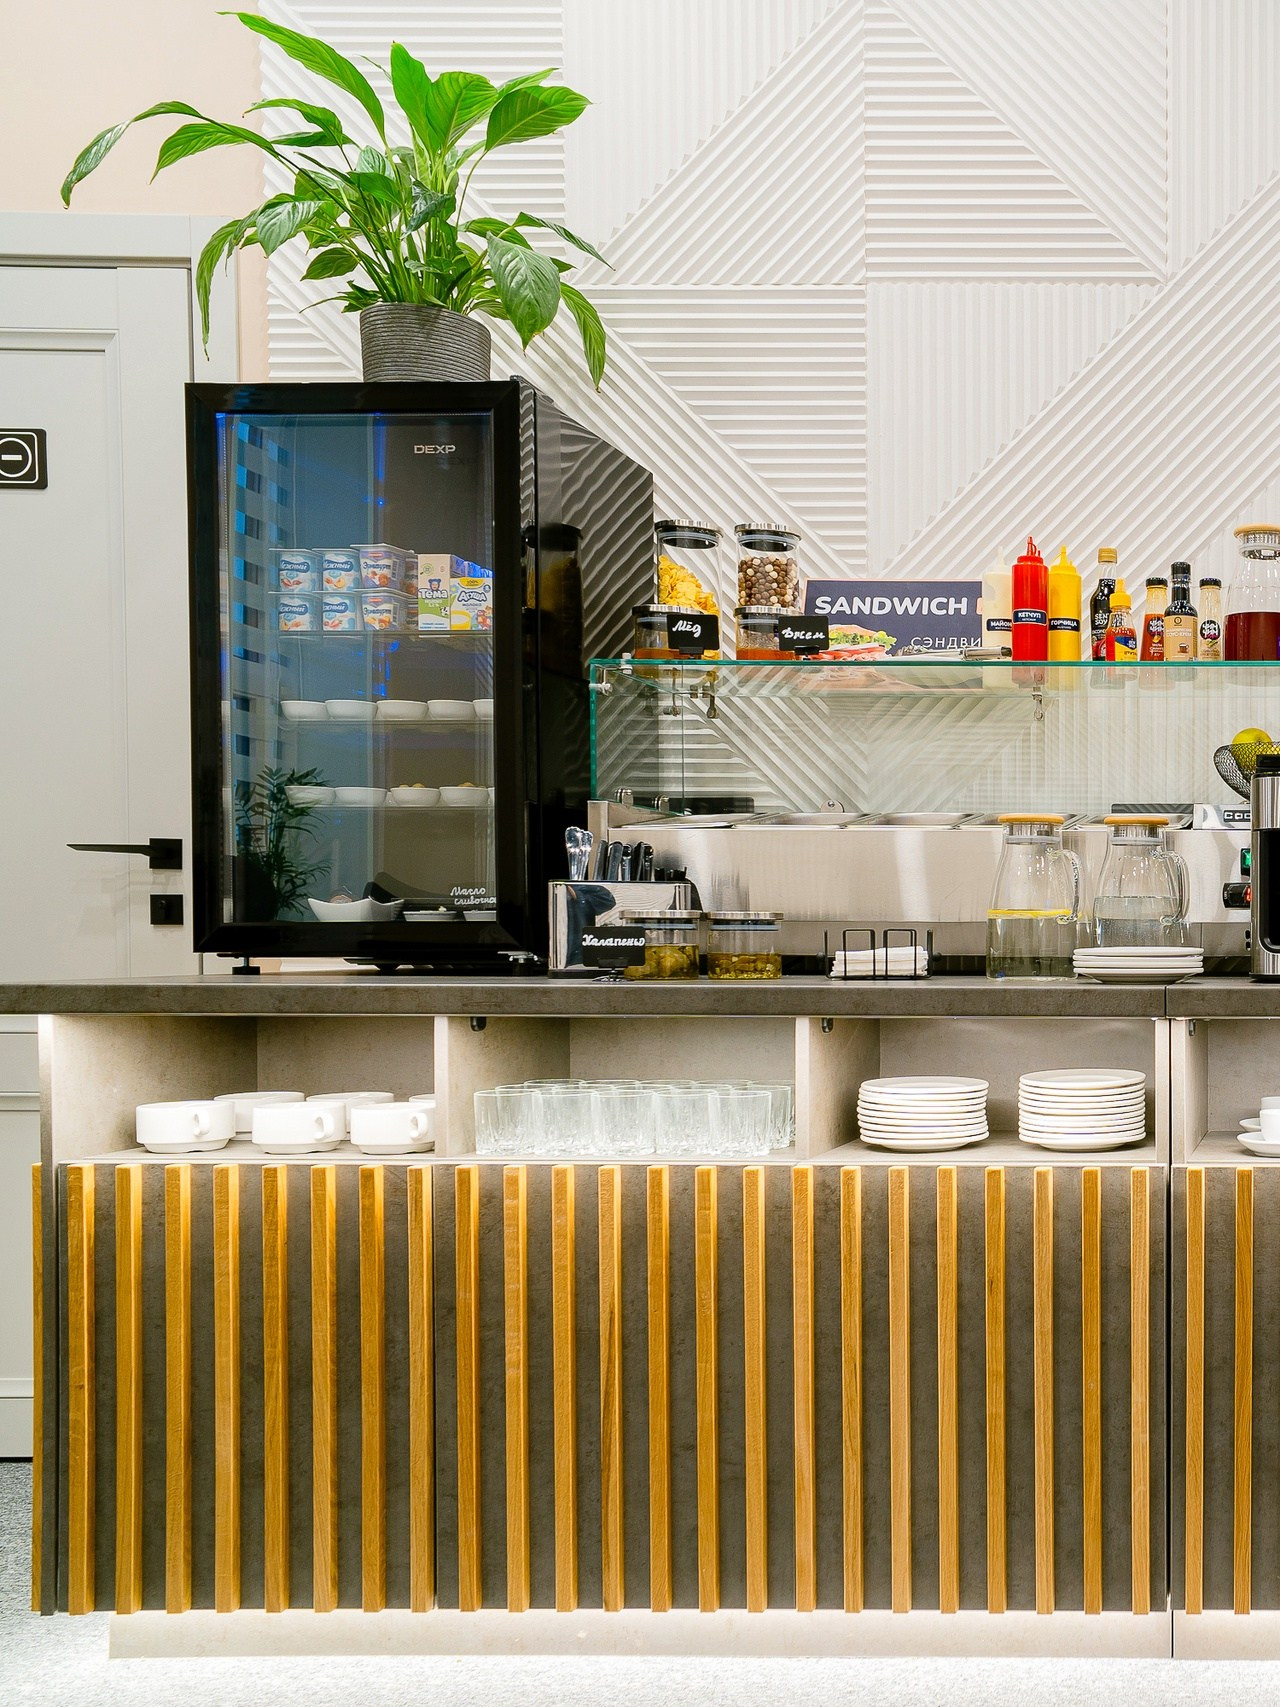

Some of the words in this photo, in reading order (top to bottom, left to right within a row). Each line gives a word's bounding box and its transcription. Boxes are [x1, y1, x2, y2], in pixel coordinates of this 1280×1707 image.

[413, 444, 456, 454] DEXP
[814, 596, 968, 615] SANDWICH
[582, 934, 646, 946] Халапеньо
